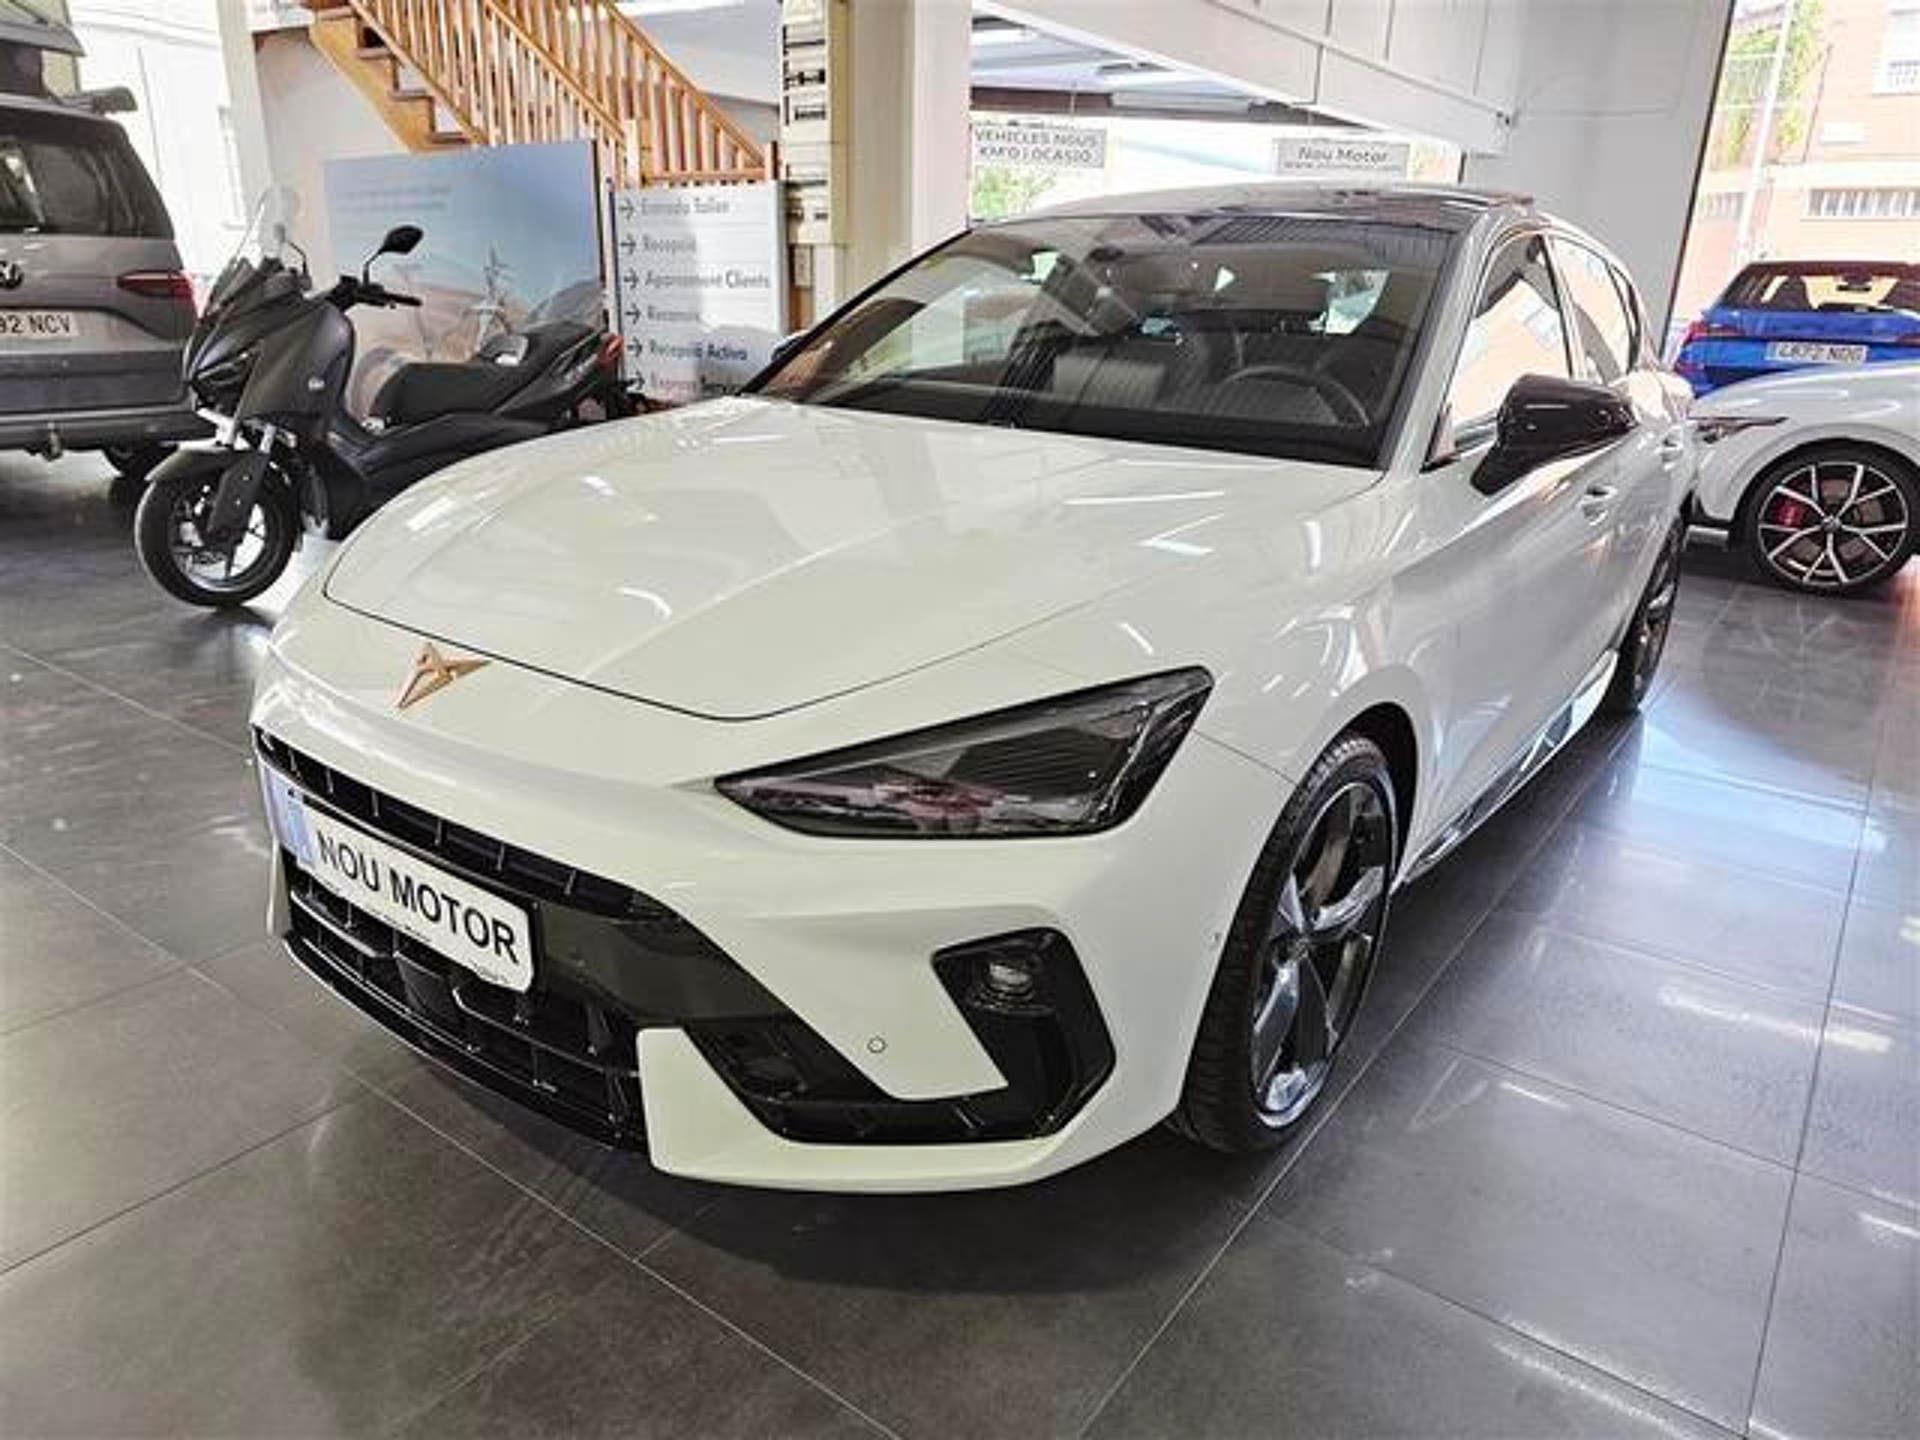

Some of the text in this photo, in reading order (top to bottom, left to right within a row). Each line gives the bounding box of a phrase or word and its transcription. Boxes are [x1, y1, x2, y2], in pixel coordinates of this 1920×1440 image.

[1298, 145, 1388, 163] Nou Motor
[27, 314, 71, 334] NCV
[316, 829, 380, 893] NOU
[388, 868, 519, 966] MOTOR
